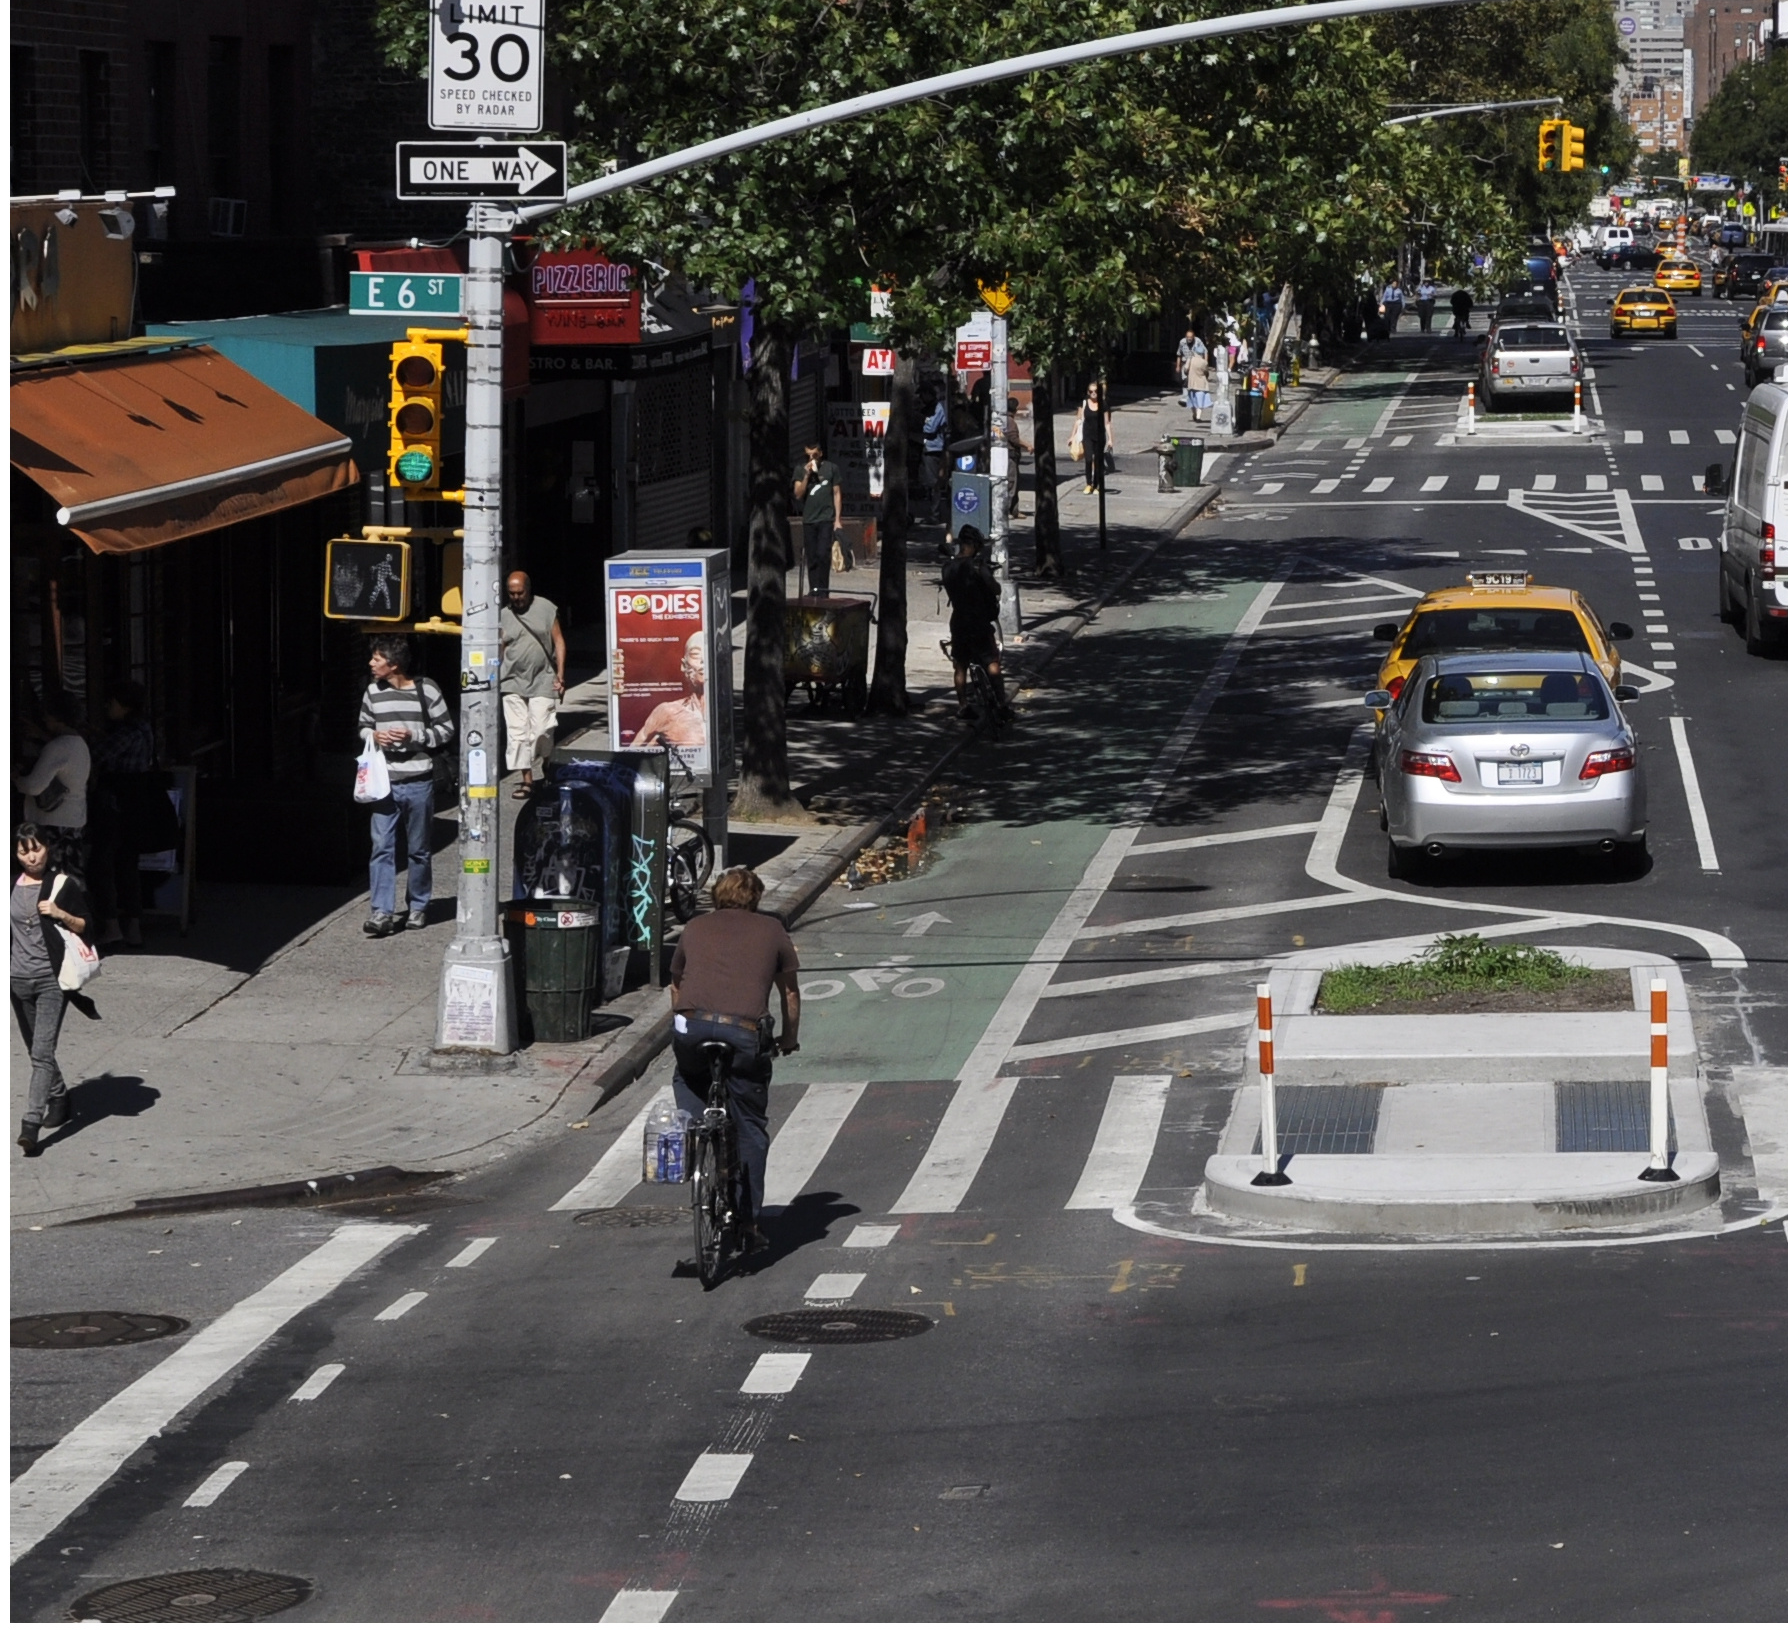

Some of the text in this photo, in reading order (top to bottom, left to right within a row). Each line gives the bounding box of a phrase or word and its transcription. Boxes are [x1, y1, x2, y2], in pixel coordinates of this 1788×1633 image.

[449, 4, 525, 25] LIMIT
[442, 32, 531, 83] 30
[440, 88, 532, 102] SPEED CHECKED
[456, 103, 515, 116] BY RADAR
[423, 160, 540, 182] ONE WAY
[532, 263, 632, 295] PIZZERIA
[368, 277, 444, 309] E 6 ST
[832, 420, 884, 438] ATM
